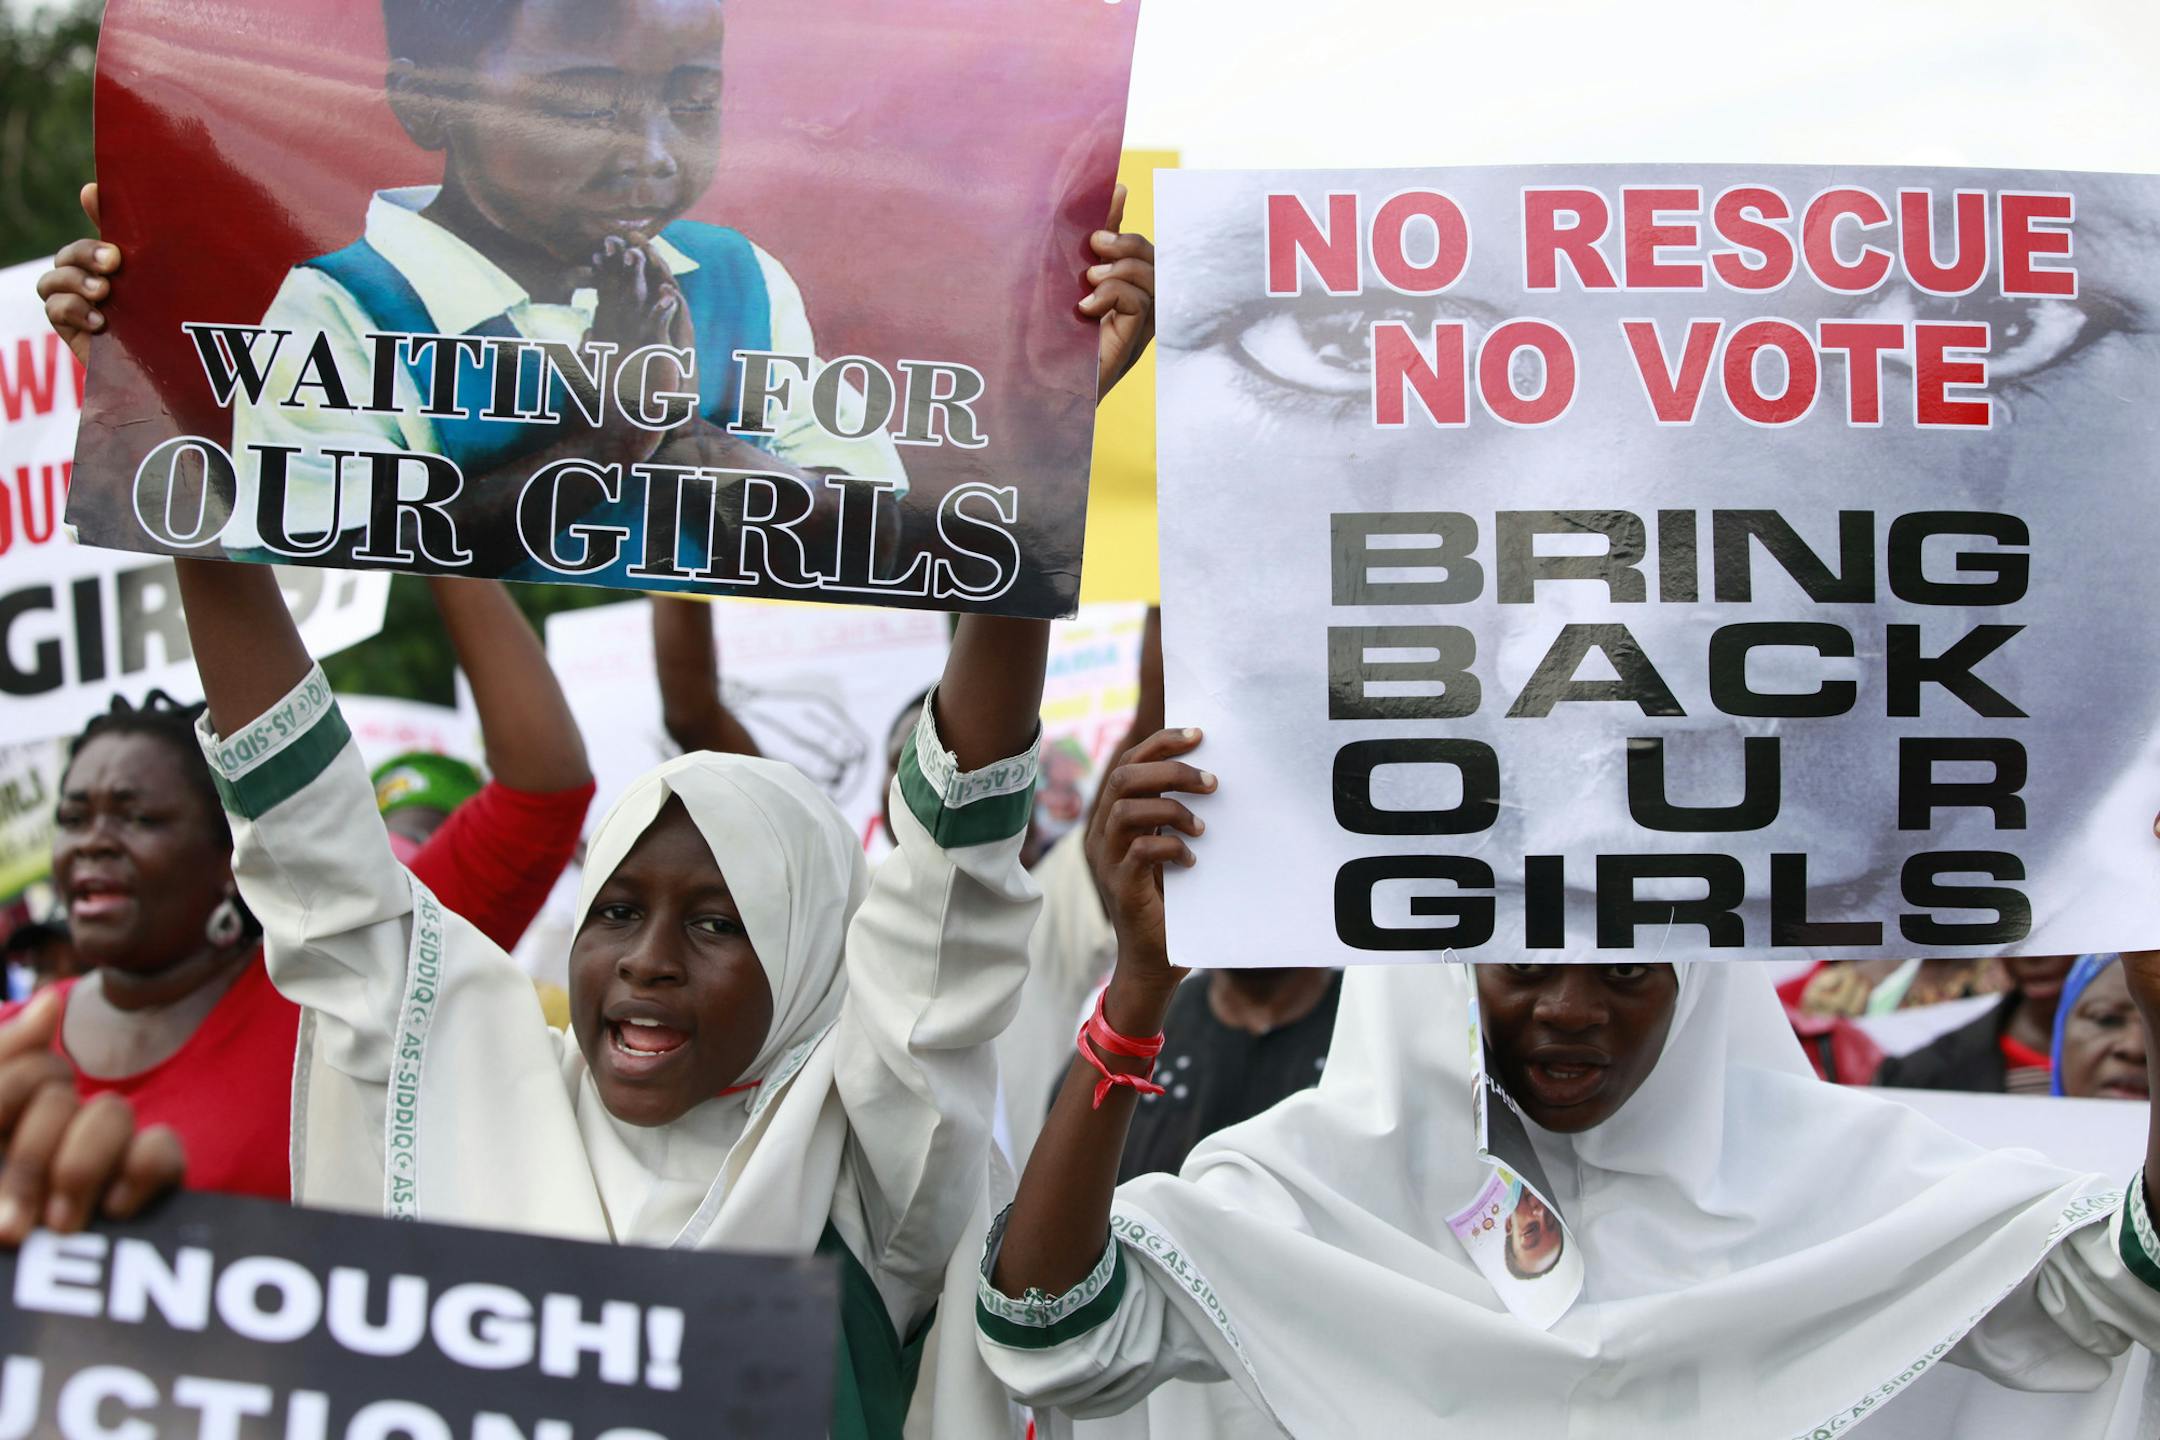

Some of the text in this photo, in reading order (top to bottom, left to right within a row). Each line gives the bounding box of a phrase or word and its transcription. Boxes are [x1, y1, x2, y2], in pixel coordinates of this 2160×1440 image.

[1264, 184, 2080, 299] NO RESCUE
[182, 321, 989, 451] WAITING FOR
[1370, 315, 1993, 430] NO VOTE
[133, 435, 473, 566] OUR
[516, 458, 1021, 601] GIRLS
[1330, 508, 2030, 607] BRING
[1327, 621, 2030, 720] BACK
[1332, 736, 2028, 836] OUR
[410, 895, 440, 1004] AS-SIDDIQ
[1334, 850, 2032, 951] GIRLS
[390, 1031, 422, 1150] AS-SIDDIQ
[13, 1232, 685, 1391] ENOUGH!
[1851, 1342, 1949, 1418] AS-SIDDIQ
